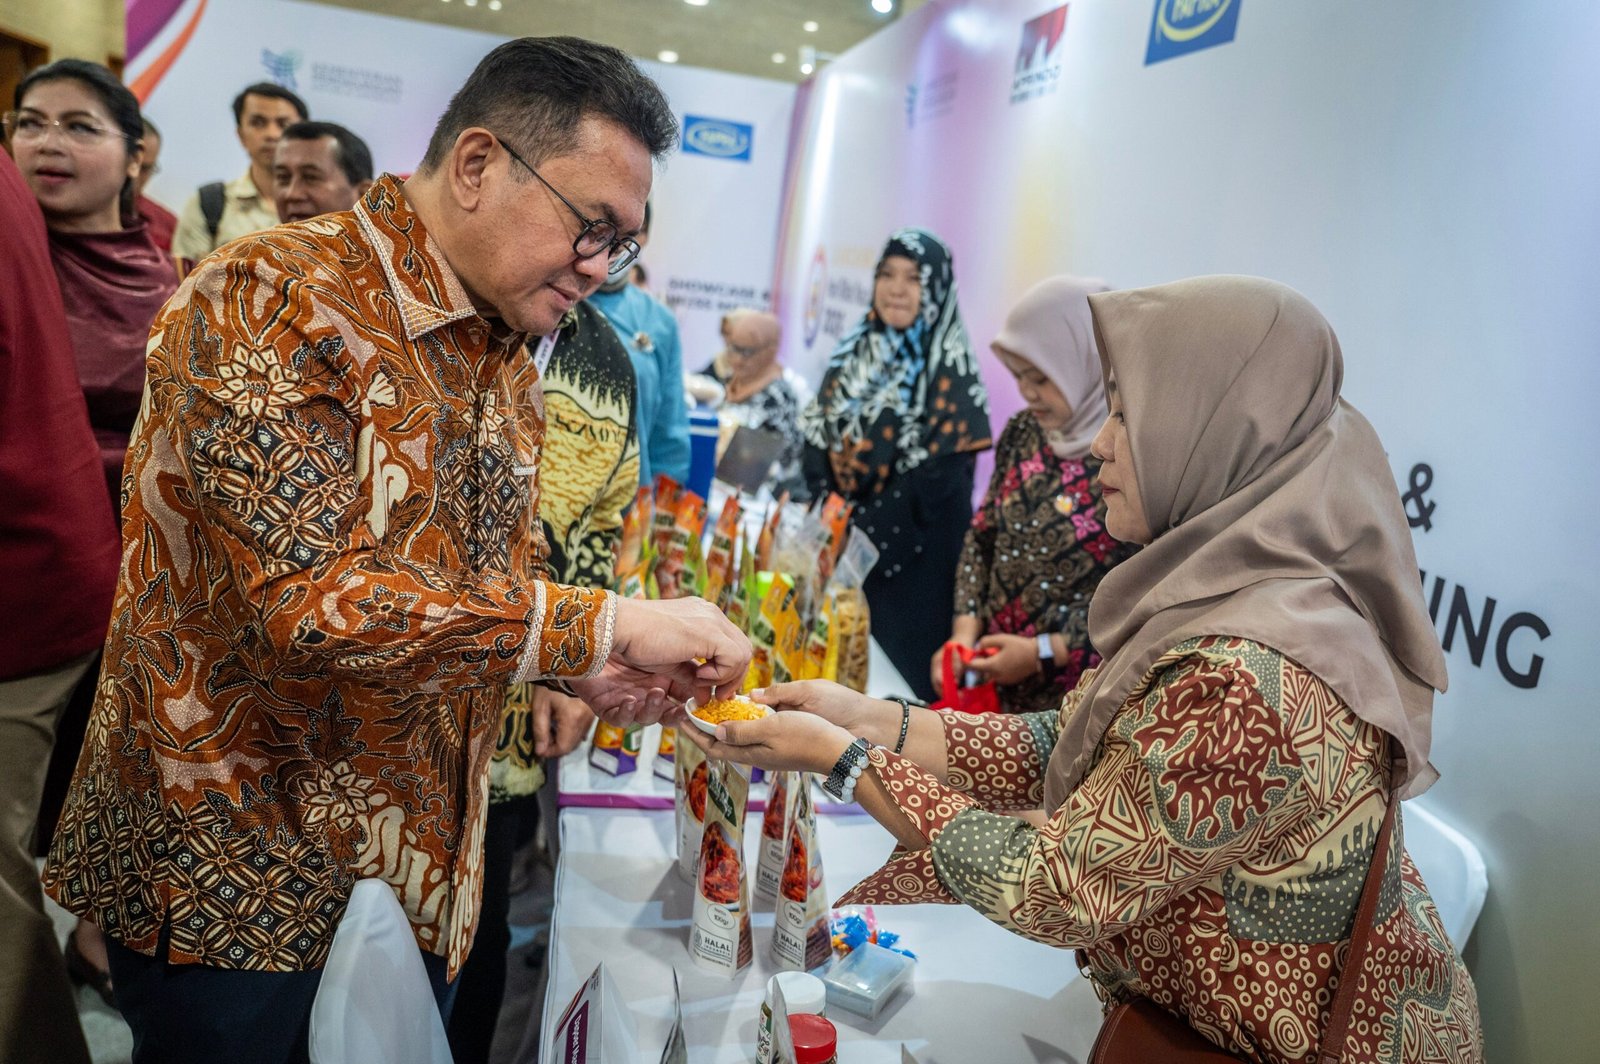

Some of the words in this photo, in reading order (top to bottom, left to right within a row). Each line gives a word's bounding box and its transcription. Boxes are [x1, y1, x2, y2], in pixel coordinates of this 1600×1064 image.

[1401, 463, 1436, 533] &
[1418, 568, 1551, 689] ING
[704, 936, 731, 952] HALAL
[780, 933, 803, 951] HALAL
